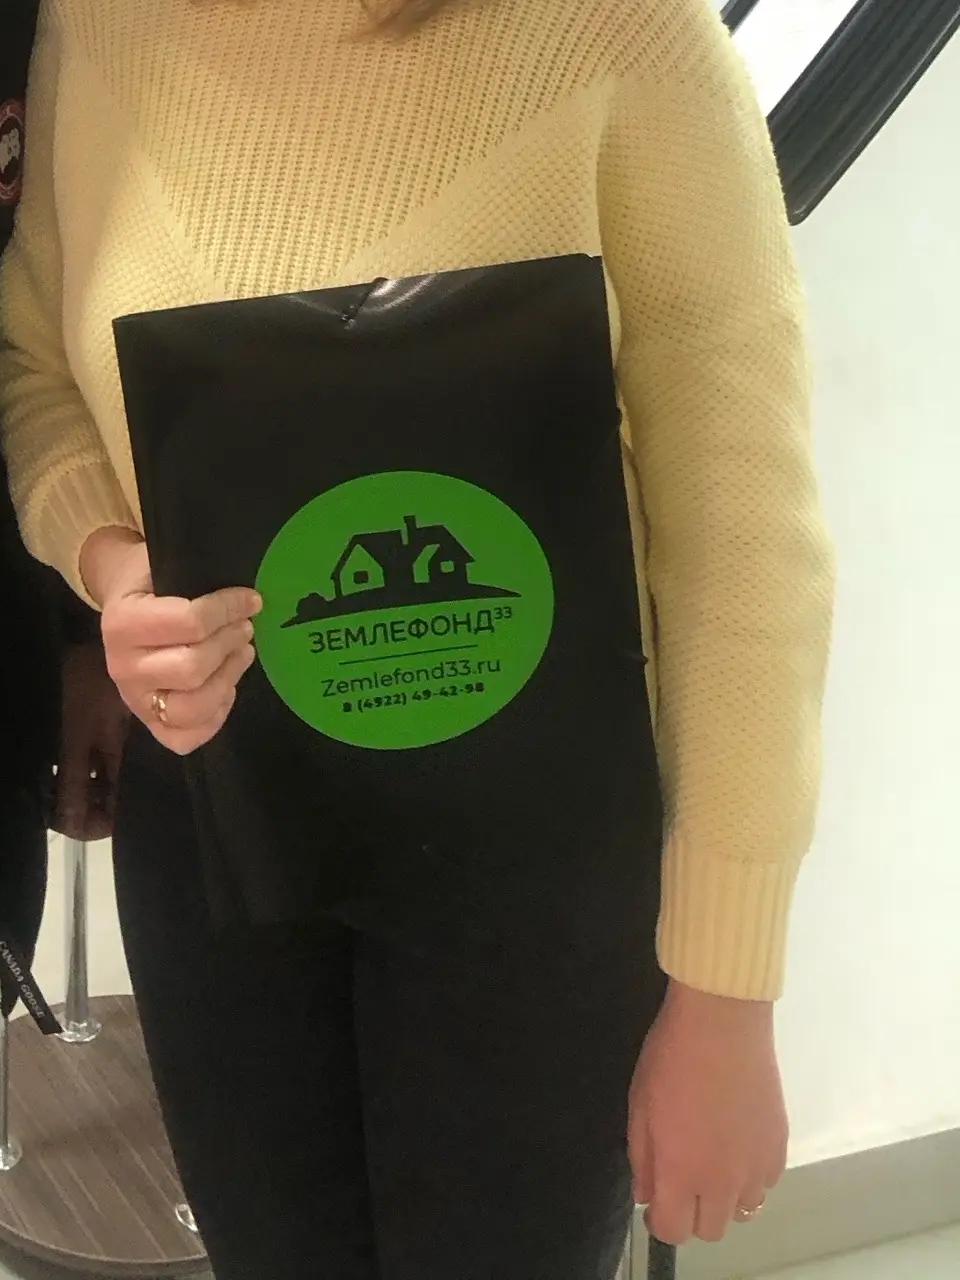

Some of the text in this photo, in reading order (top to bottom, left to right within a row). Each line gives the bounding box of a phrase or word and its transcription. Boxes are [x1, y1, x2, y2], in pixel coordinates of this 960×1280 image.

[321, 659, 502, 698] Zemlefond33.ru
[357, 692, 407, 713] (4922)
[412, 682, 485, 701] 49-42-98
